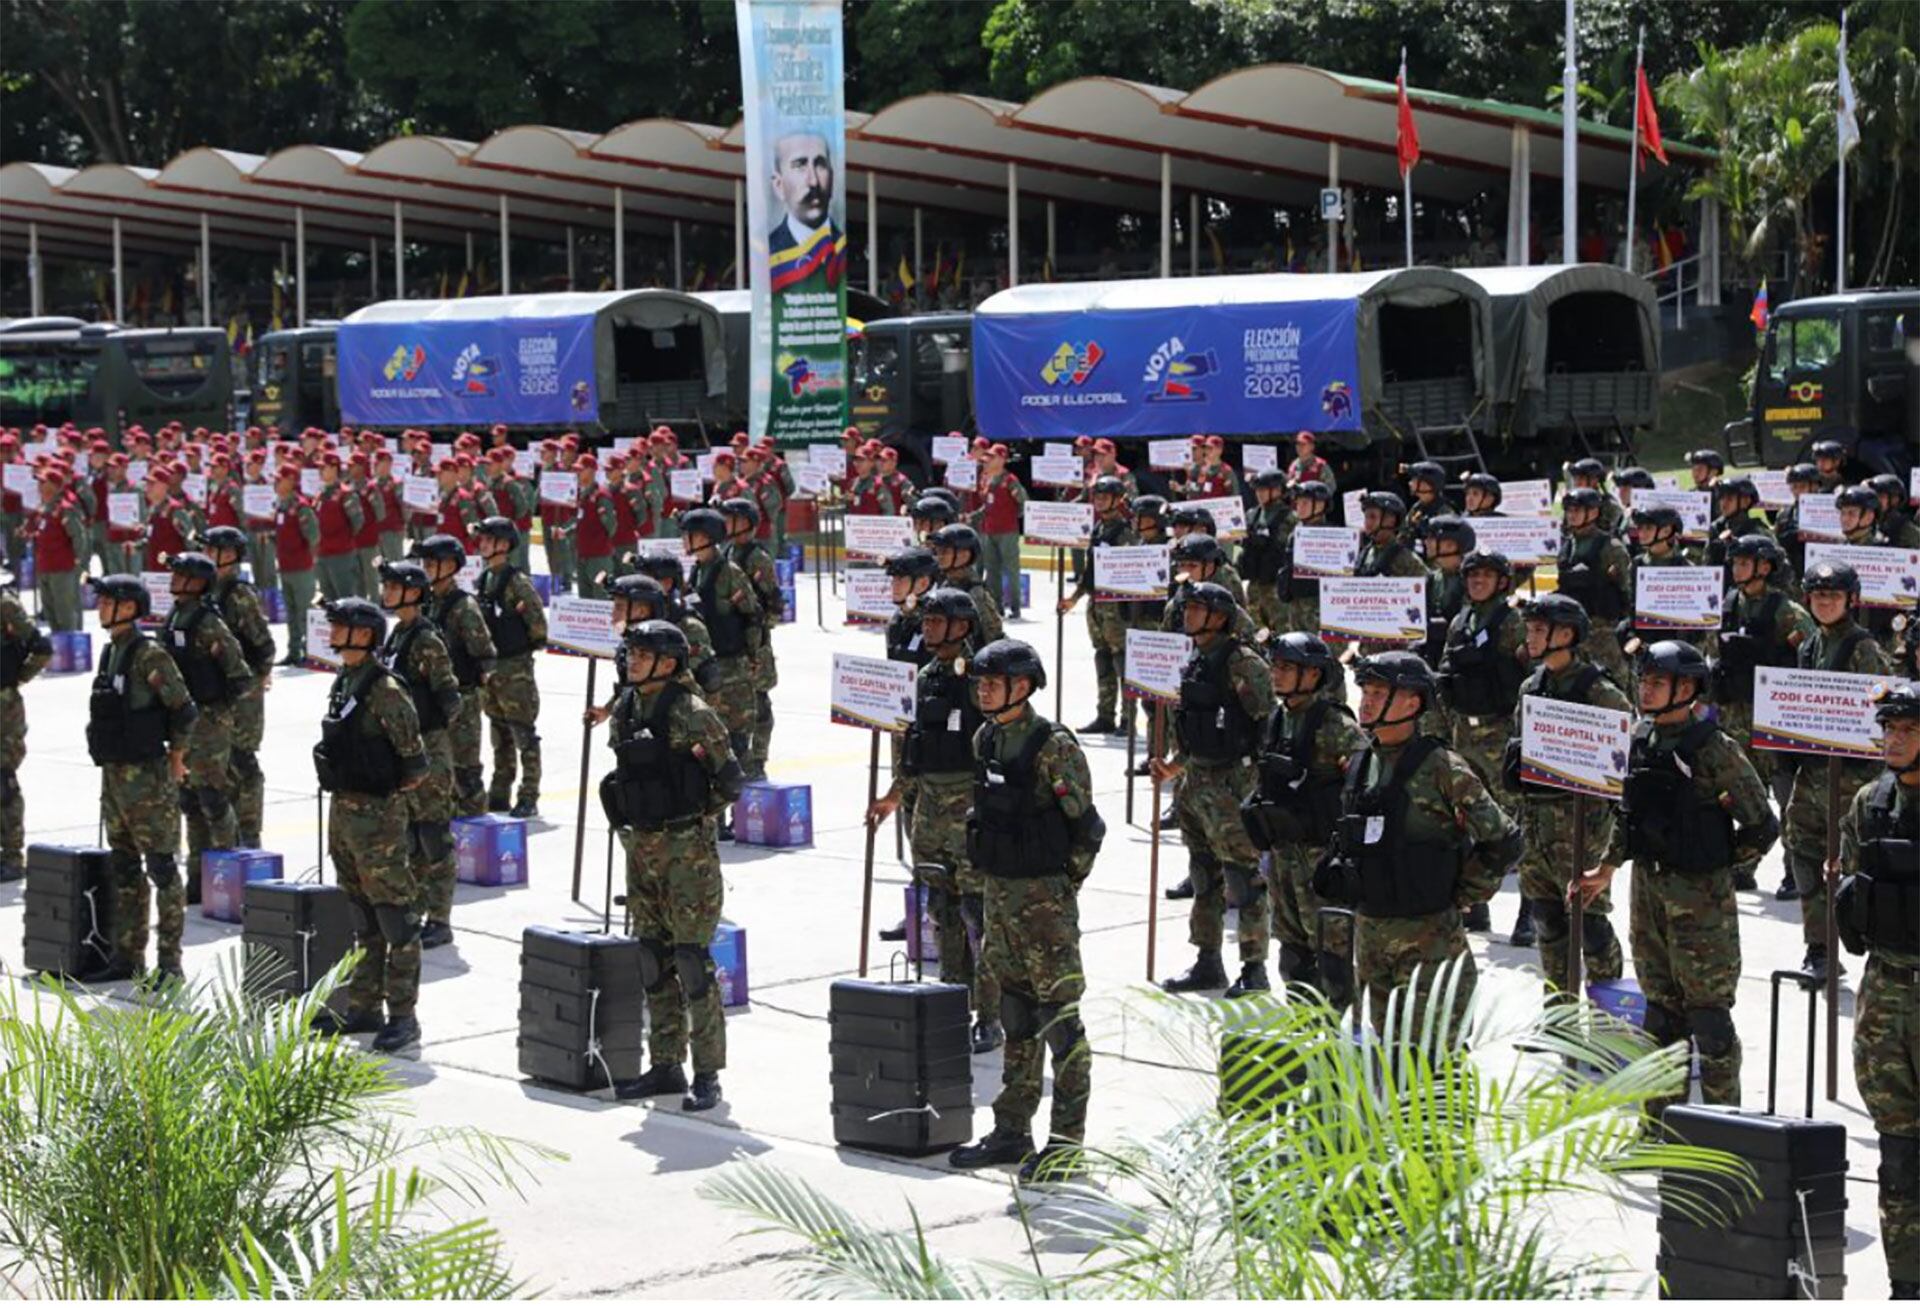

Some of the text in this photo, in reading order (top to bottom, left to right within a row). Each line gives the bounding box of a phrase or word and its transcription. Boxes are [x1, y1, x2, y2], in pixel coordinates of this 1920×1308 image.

[1323, 191, 1338, 215] P
[1244, 321, 1300, 348] ELECCIÓN
[451, 343, 480, 381] VOTA
[1143, 337, 1186, 383] VOTA
[1244, 374, 1302, 398] 2024
[1021, 392, 1127, 407] PODER ELECTORAL
[1330, 596, 1351, 605] ZODI
[1353, 596, 1389, 605] CAPITAL
[1770, 690, 1801, 702] ZODI
[1805, 693, 1857, 707] CAPITAL
[1533, 721, 1556, 734] ZODI
[1557, 726, 1594, 743] CAPITAL
